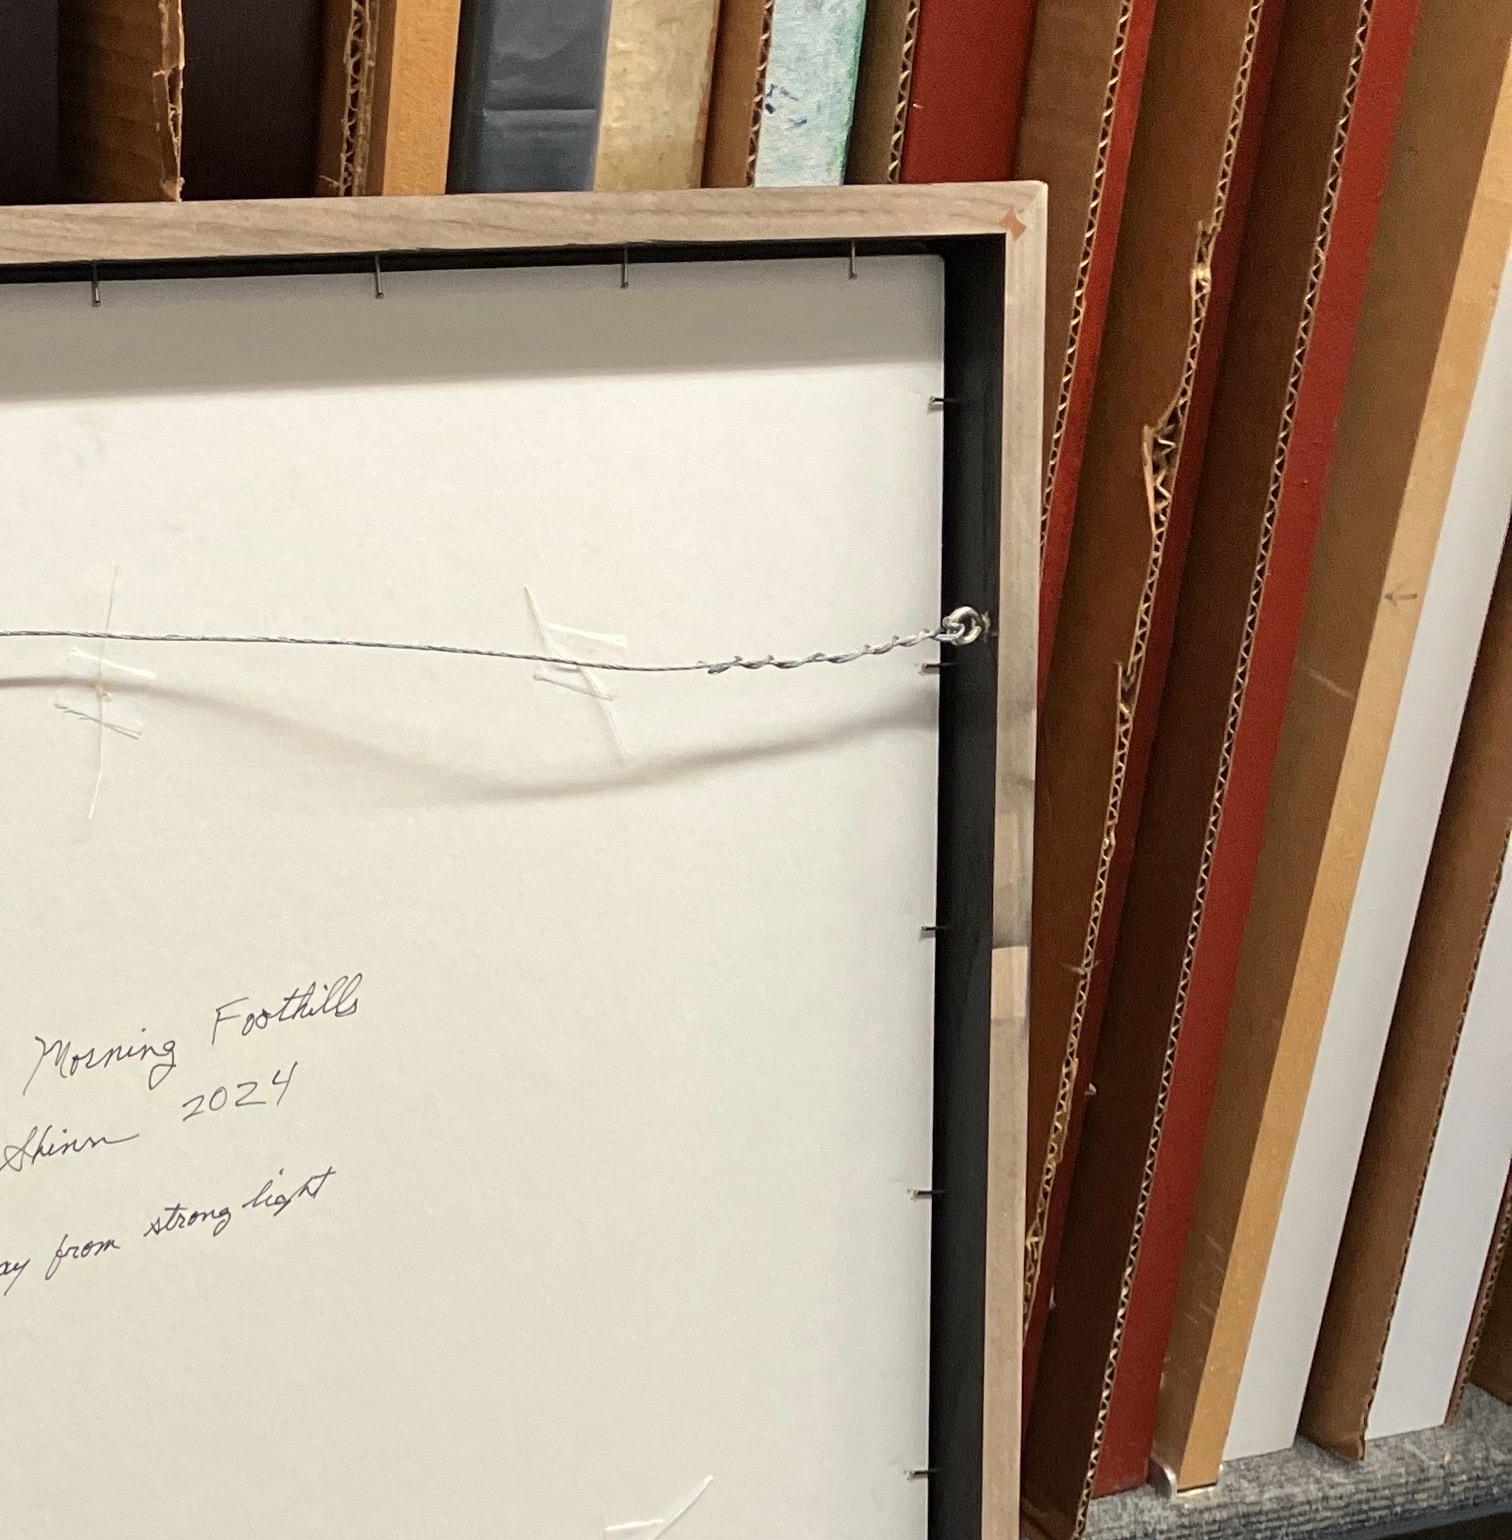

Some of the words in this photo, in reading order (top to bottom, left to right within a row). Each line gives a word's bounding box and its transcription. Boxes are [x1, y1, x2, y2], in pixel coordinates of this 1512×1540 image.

[22, 1028, 176, 1096] Morning
[211, 973, 363, 1046] Foothills
[182, 1061, 298, 1122] 2024
[45, 1233, 120, 1280] from
[143, 1203, 231, 1237] strong
[242, 1166, 336, 1217] light
